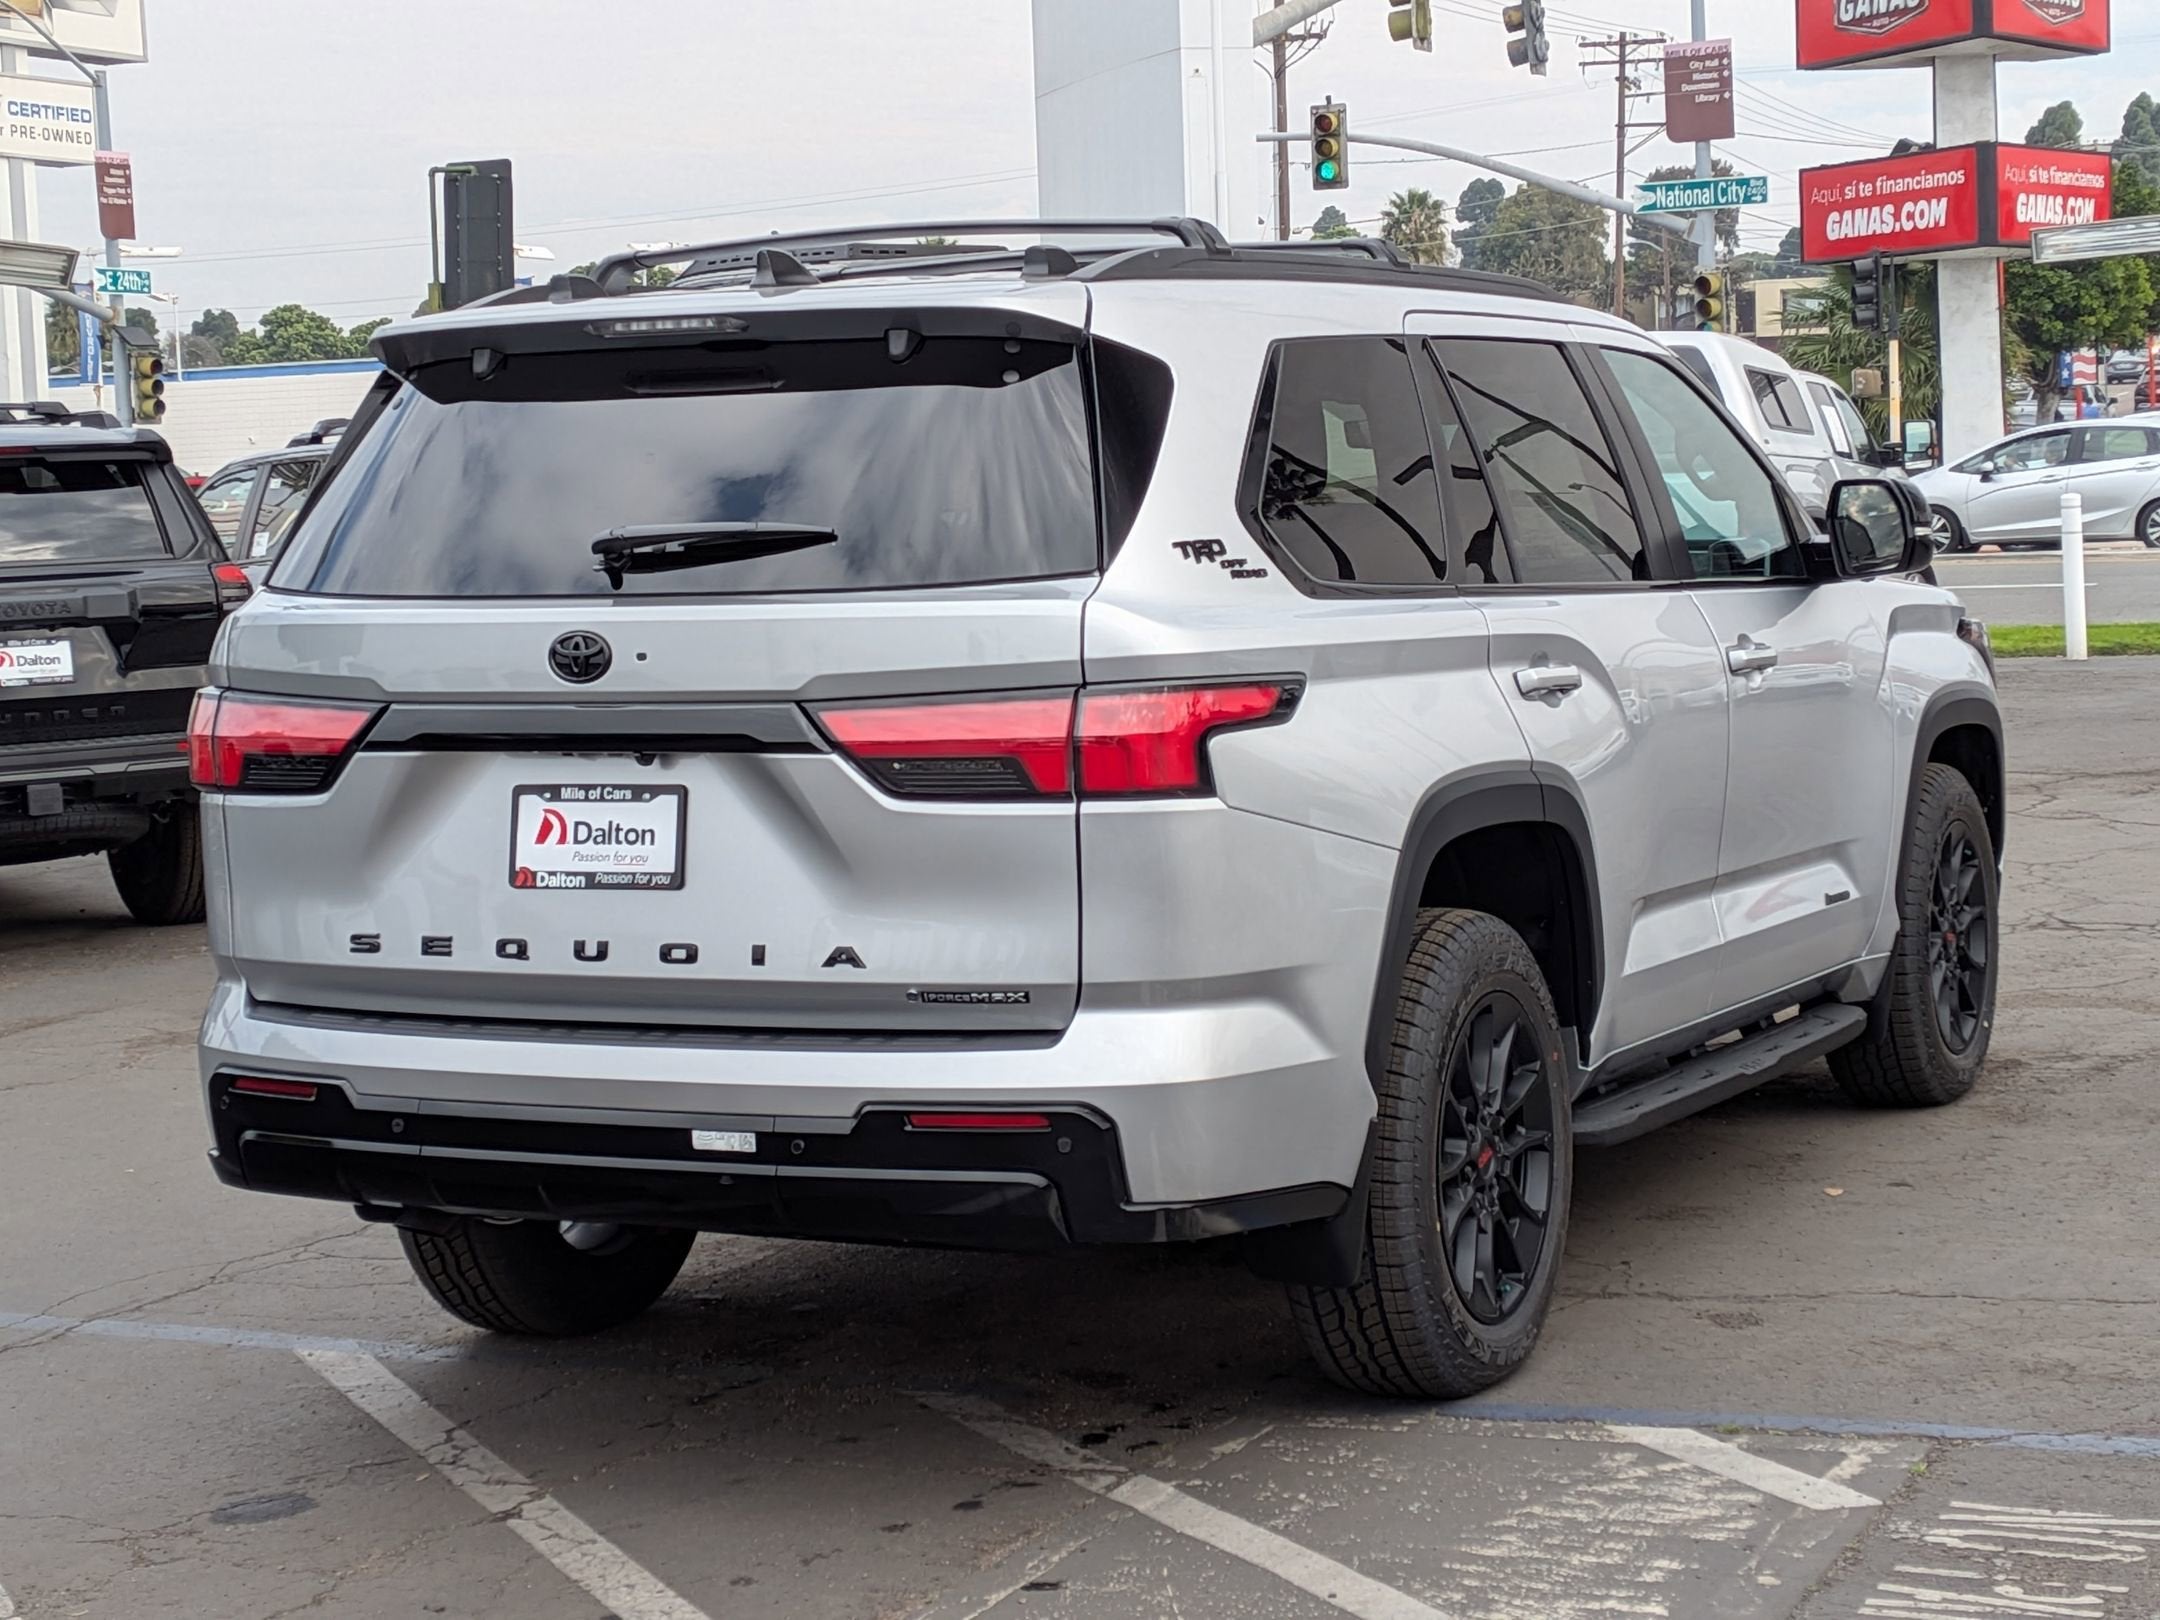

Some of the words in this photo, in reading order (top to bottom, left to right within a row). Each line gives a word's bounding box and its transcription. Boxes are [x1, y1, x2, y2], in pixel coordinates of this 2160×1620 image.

[1689, 60, 1704, 70] City
[1695, 94, 1720, 103] Library
[7, 100, 92, 123] CERTIFIED
[10, 124, 92, 145] PRE-OWNED
[1810, 183, 1843, 206] Aquí,
[1844, 180, 1857, 200] sí
[1859, 182, 1873, 198] te
[1876, 169, 1965, 195] financiamos
[2038, 166, 2049, 184] te
[2049, 165, 2105, 188] financiamos
[1655, 182, 1714, 208] National
[1717, 181, 1747, 204] City
[1826, 197, 1948, 241] GANAS.COM
[2016, 192, 2095, 225] GANAS.COM
[105, 271, 116, 290] E
[116, 271, 141, 290] 24th
[1171, 539, 1227, 564] TRD
[0, 602, 71, 618] OYOTA
[16, 654, 61, 667] Dalton
[560, 787, 585, 800] Mile
[588, 787, 601, 800] of
[603, 787, 632, 800] Cars
[572, 820, 655, 846] Dalton
[572, 851, 610, 863] Passion
[613, 851, 629, 863] for
[630, 855, 648, 865] you
[536, 872, 585, 888] Dalton
[595, 873, 633, 885] Passion
[634, 873, 650, 885] for
[651, 876, 671, 887] you
[349, 933, 867, 969] SEQUOIA
